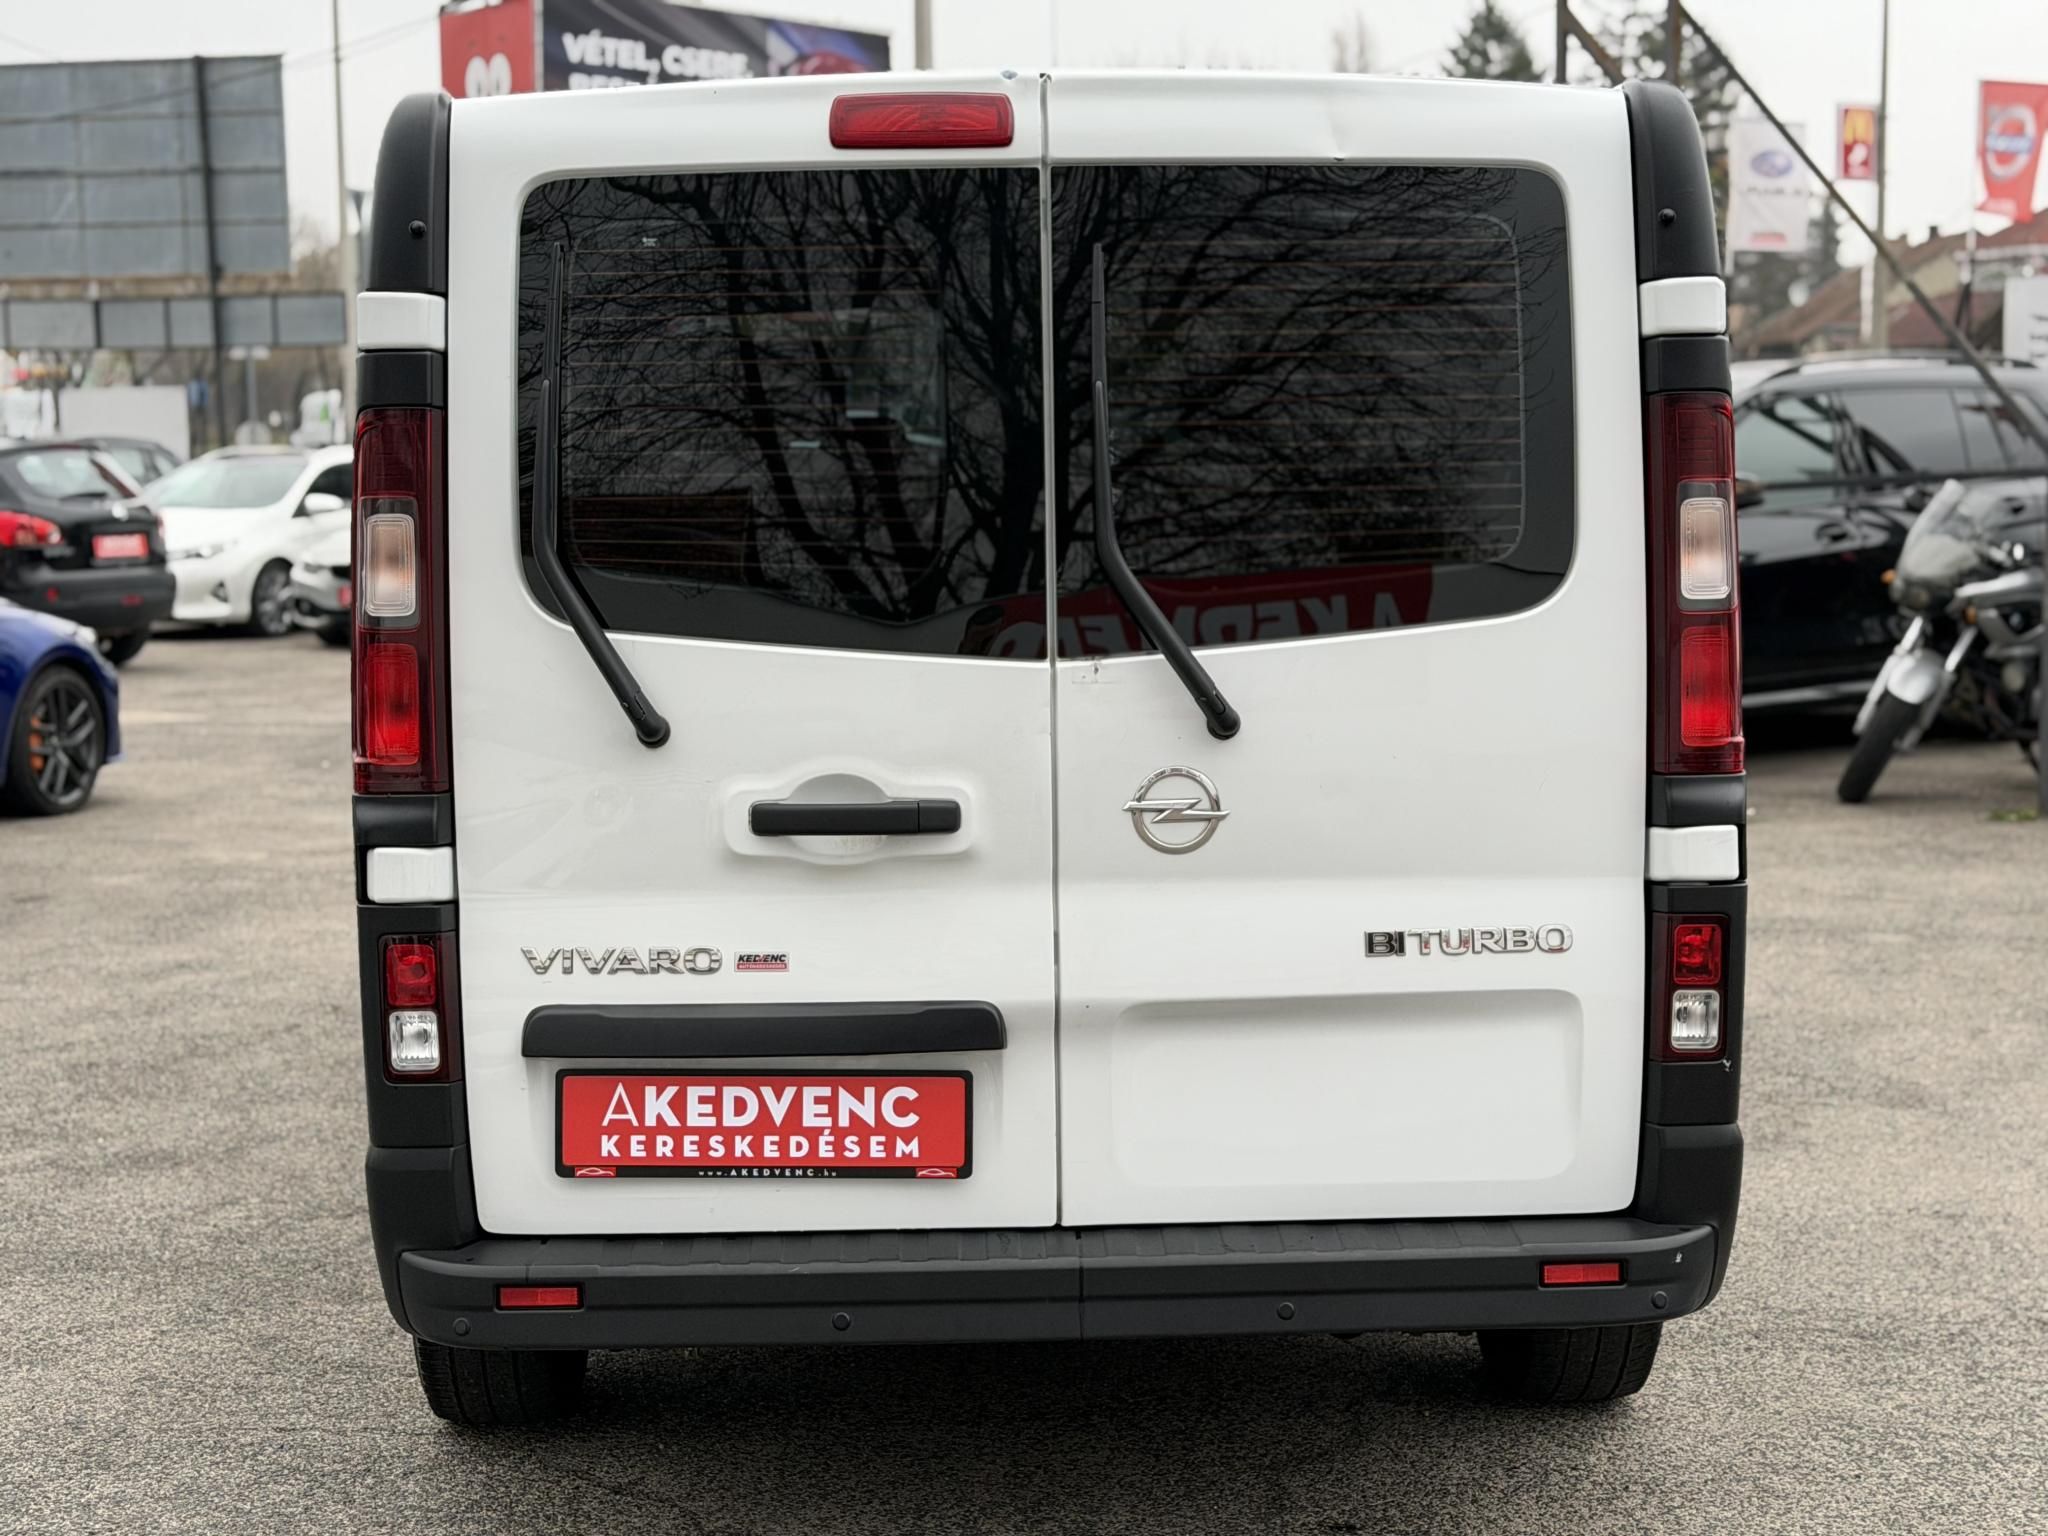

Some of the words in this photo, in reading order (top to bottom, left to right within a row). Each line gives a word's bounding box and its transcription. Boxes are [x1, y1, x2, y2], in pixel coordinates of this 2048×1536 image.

[520, 946, 723, 976] VIVARO
[600, 1129, 921, 1158] KERESKEDÉSEM
[698, 1168, 837, 1177] www.AKEDVENC.hu
